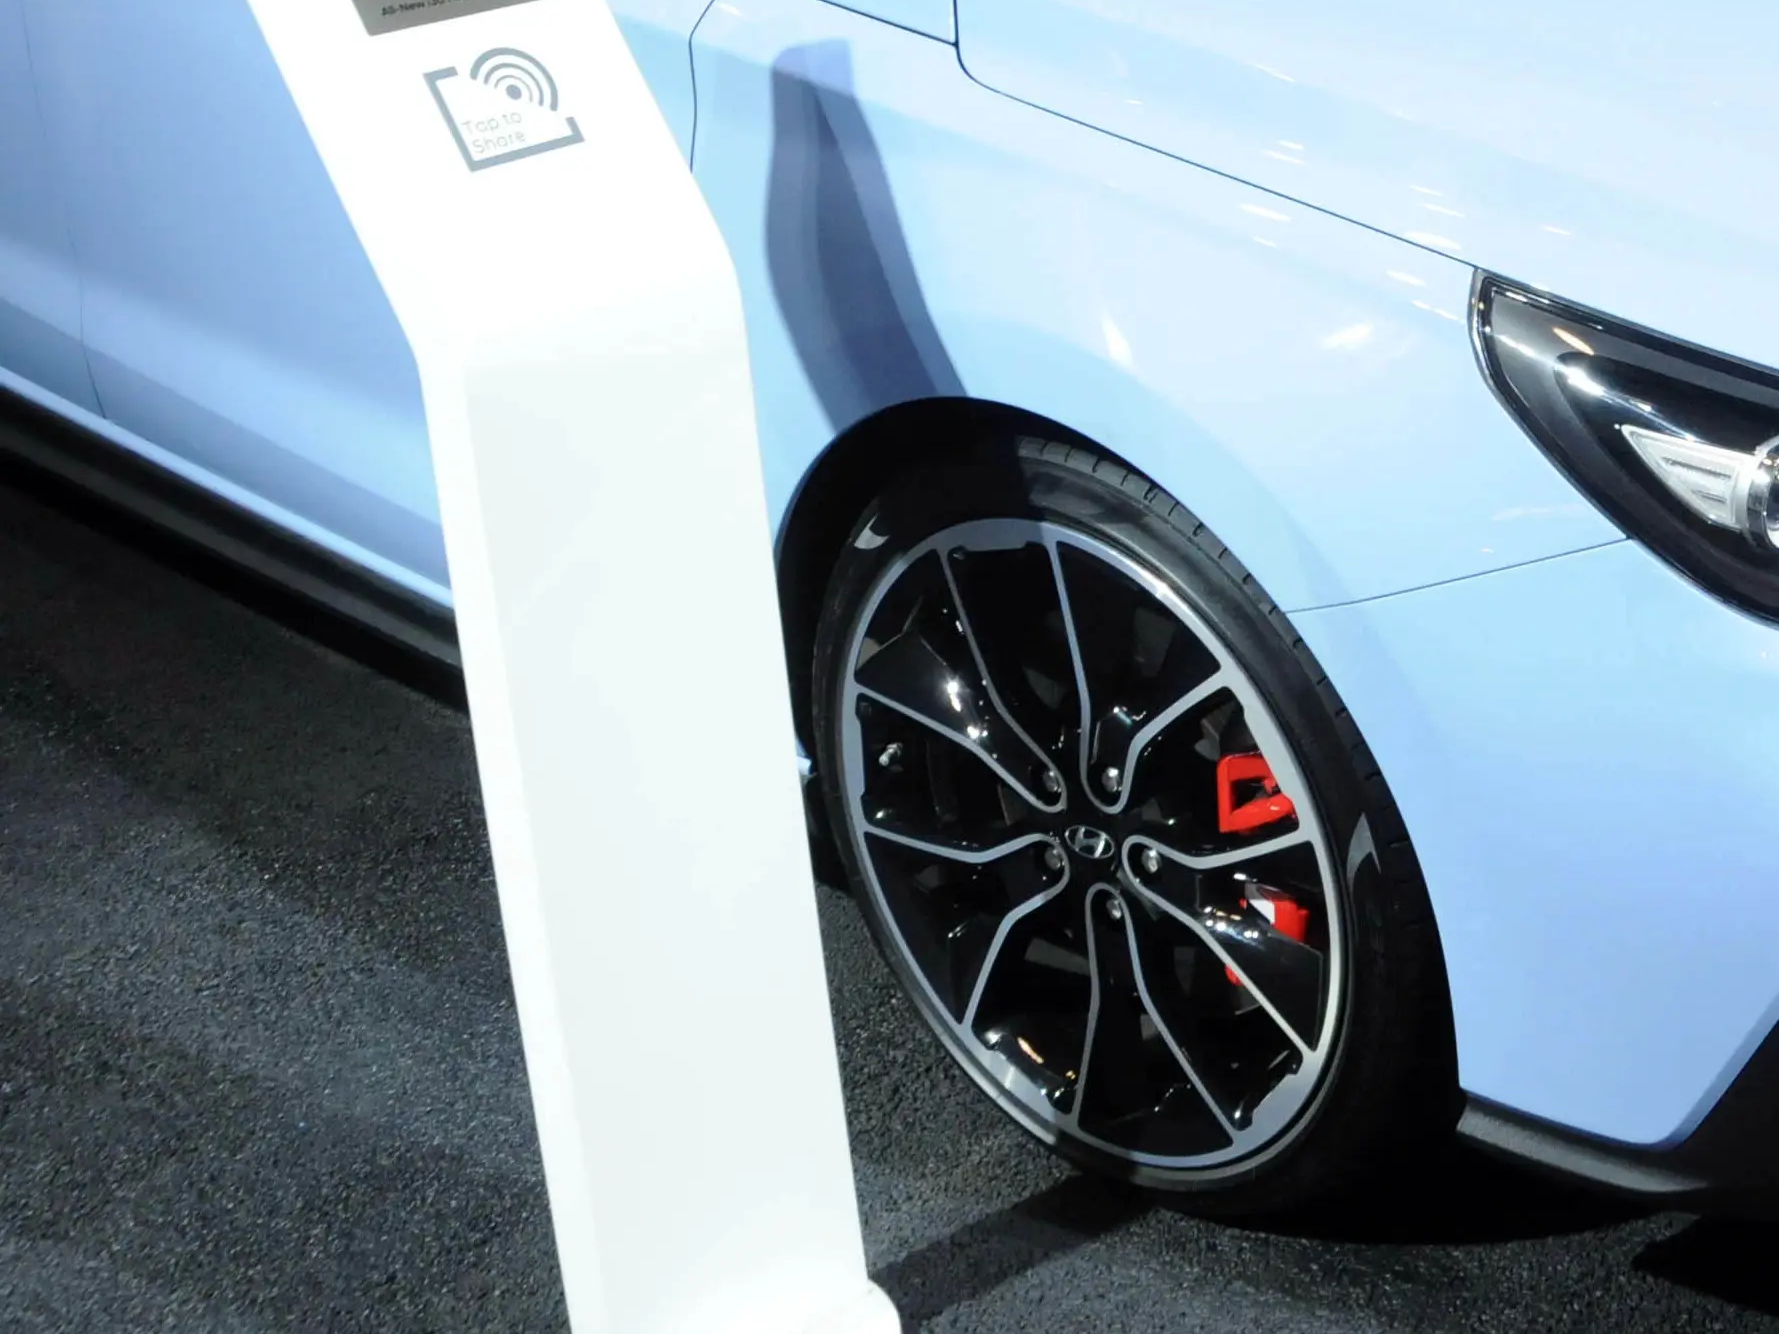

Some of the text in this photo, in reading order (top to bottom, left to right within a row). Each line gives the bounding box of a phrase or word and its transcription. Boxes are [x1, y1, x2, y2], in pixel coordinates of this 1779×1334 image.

[461, 112, 522, 135] Tap to
[472, 131, 526, 154] Share
